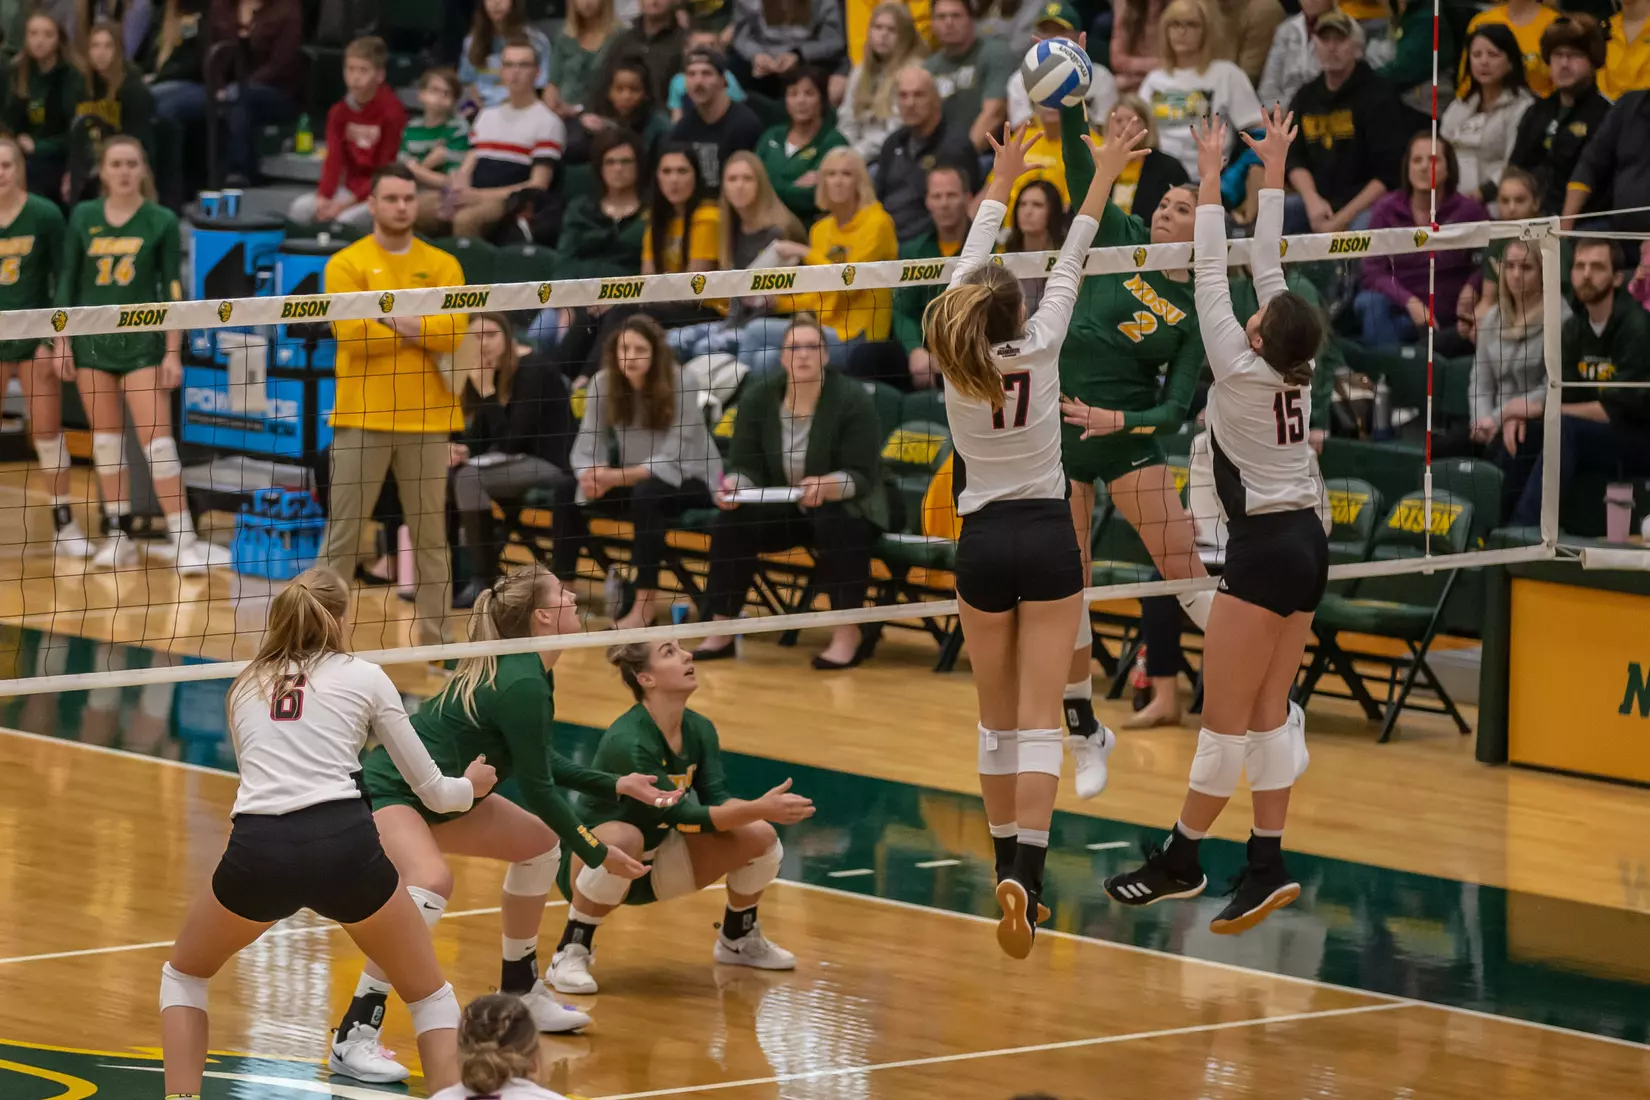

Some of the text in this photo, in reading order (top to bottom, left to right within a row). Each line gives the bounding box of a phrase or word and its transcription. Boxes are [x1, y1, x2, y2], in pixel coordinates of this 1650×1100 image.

[1328, 237, 1371, 253] BISON
[751, 273, 796, 290] BISON
[901, 264, 945, 281] BISON
[598, 282, 644, 299] BISON
[1123, 273, 1187, 326] NDSU
[281, 300, 330, 318] BISON
[441, 292, 489, 309] BISON
[117, 309, 167, 327] BISON
[1118, 310, 1158, 343] 2
[991, 370, 1031, 430] 17
[1273, 389, 1305, 445] 15
[269, 673, 307, 721] 6
